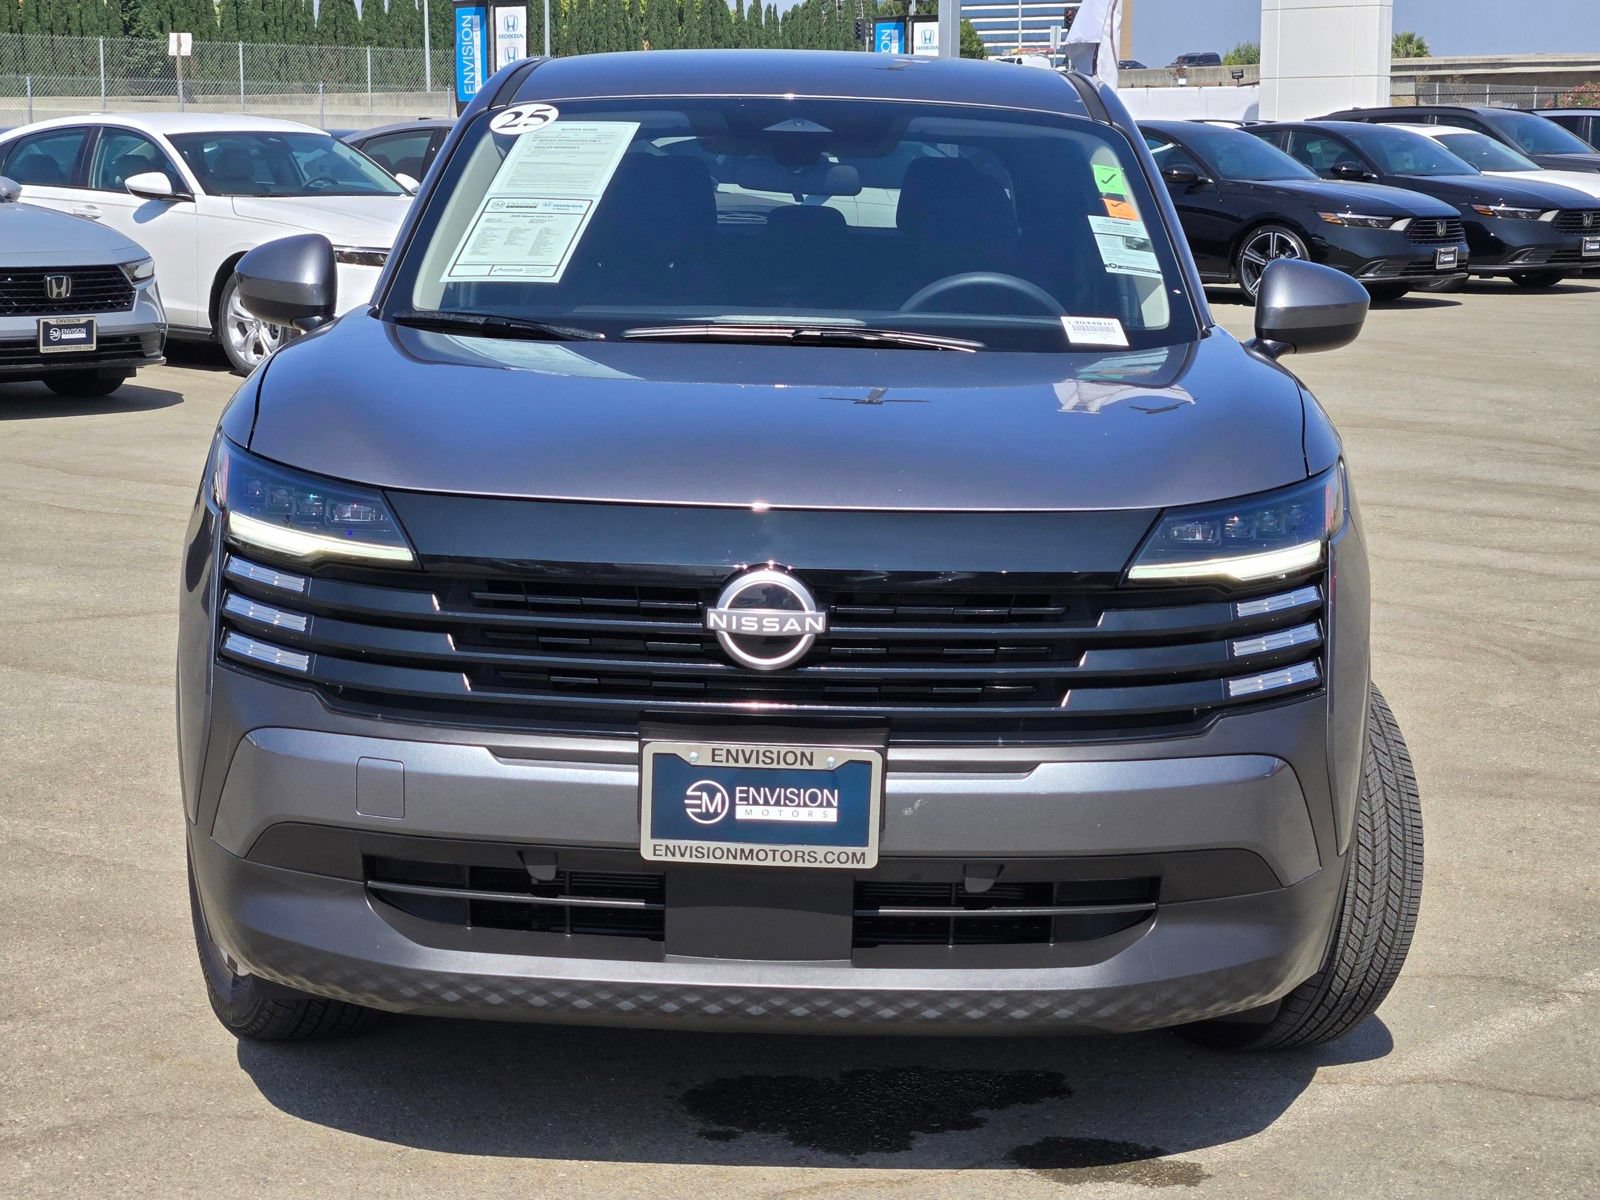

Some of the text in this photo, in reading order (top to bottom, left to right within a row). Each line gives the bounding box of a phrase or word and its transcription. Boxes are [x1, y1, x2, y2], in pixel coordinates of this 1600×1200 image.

[461, 15, 475, 94] ENVISION
[496, 108, 554, 129] 25
[709, 612, 825, 632] NISSAN
[711, 748, 815, 766] ENVISION
[735, 787, 838, 807] ENVISION
[744, 808, 828, 819] MOTORS
[652, 843, 866, 865] ENVISIONMOTORS.COM
